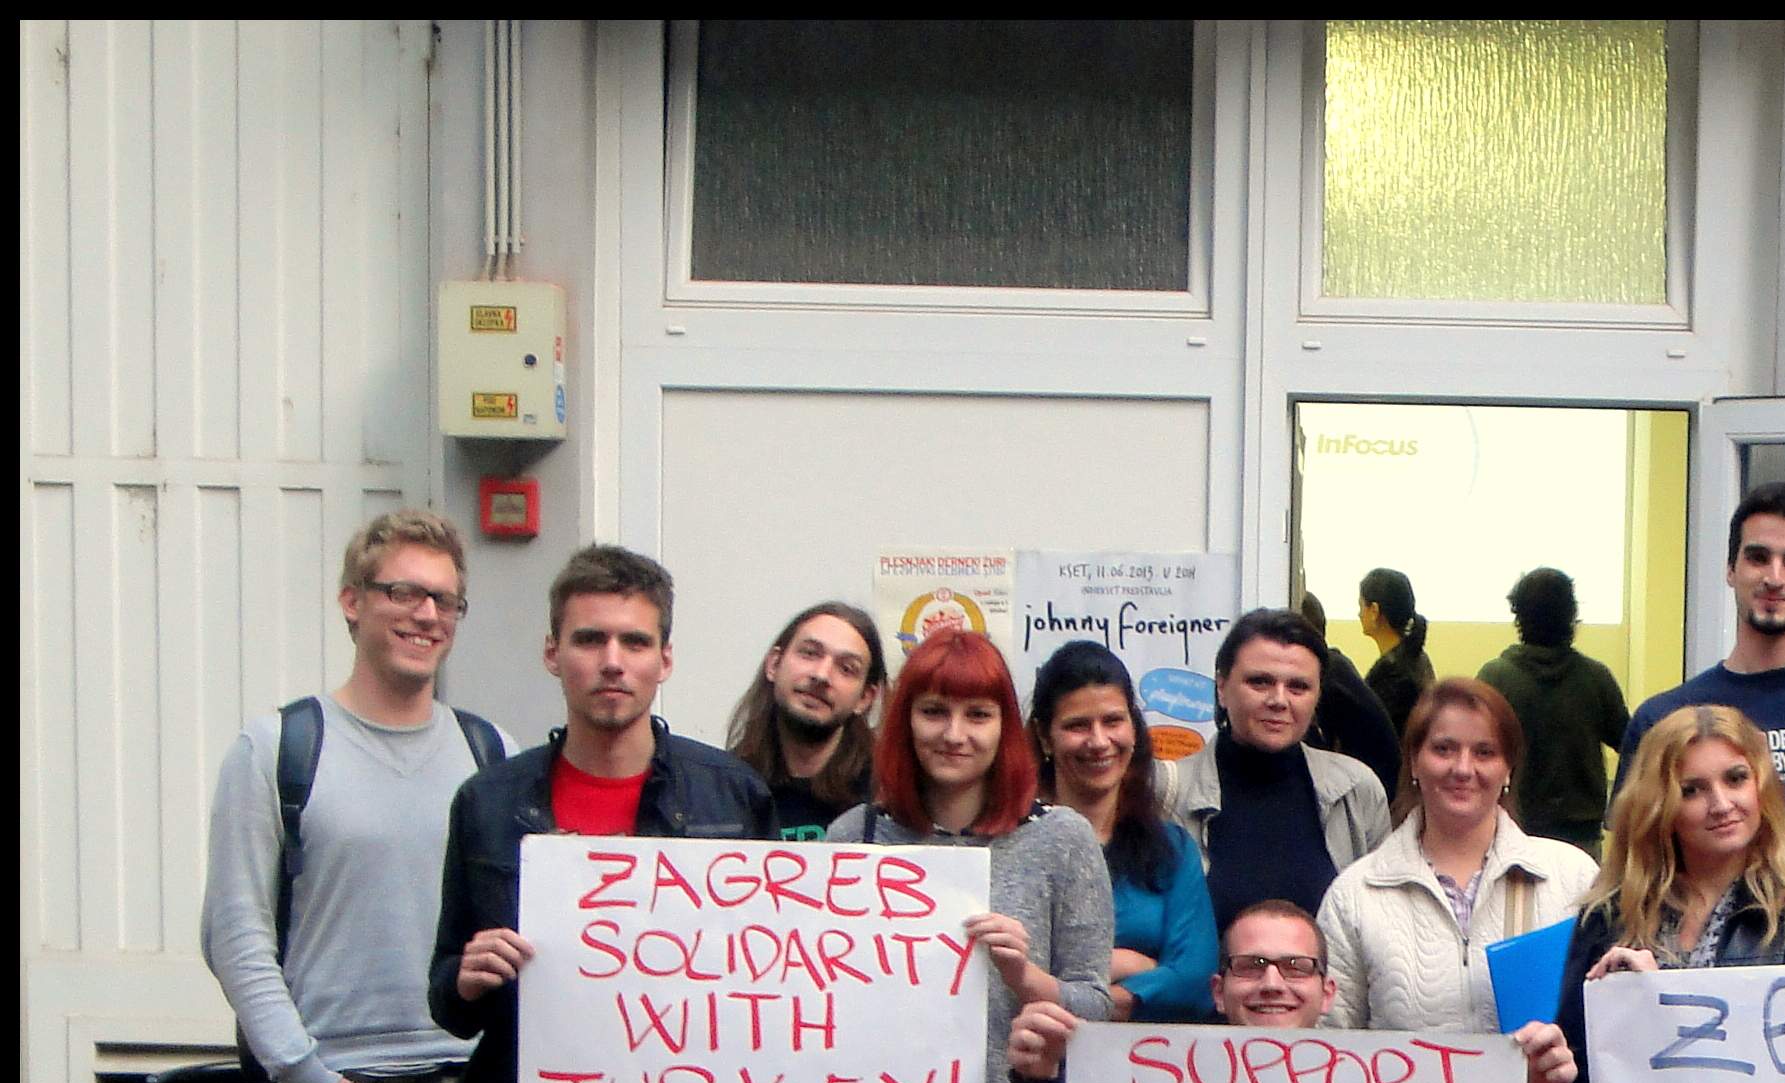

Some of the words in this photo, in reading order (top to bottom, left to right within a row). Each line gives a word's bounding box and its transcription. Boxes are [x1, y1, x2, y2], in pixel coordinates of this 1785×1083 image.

[1317, 433, 1418, 456] InFocus
[1059, 564, 1091, 581] KSET,
[1163, 566, 1172, 579] U
[1024, 601, 1110, 652] johnny
[1118, 601, 1230, 666] foreigner
[577, 849, 937, 919] ZAGREB
[578, 919, 978, 996] SOLIDARITY
[616, 991, 837, 1054] WITH
